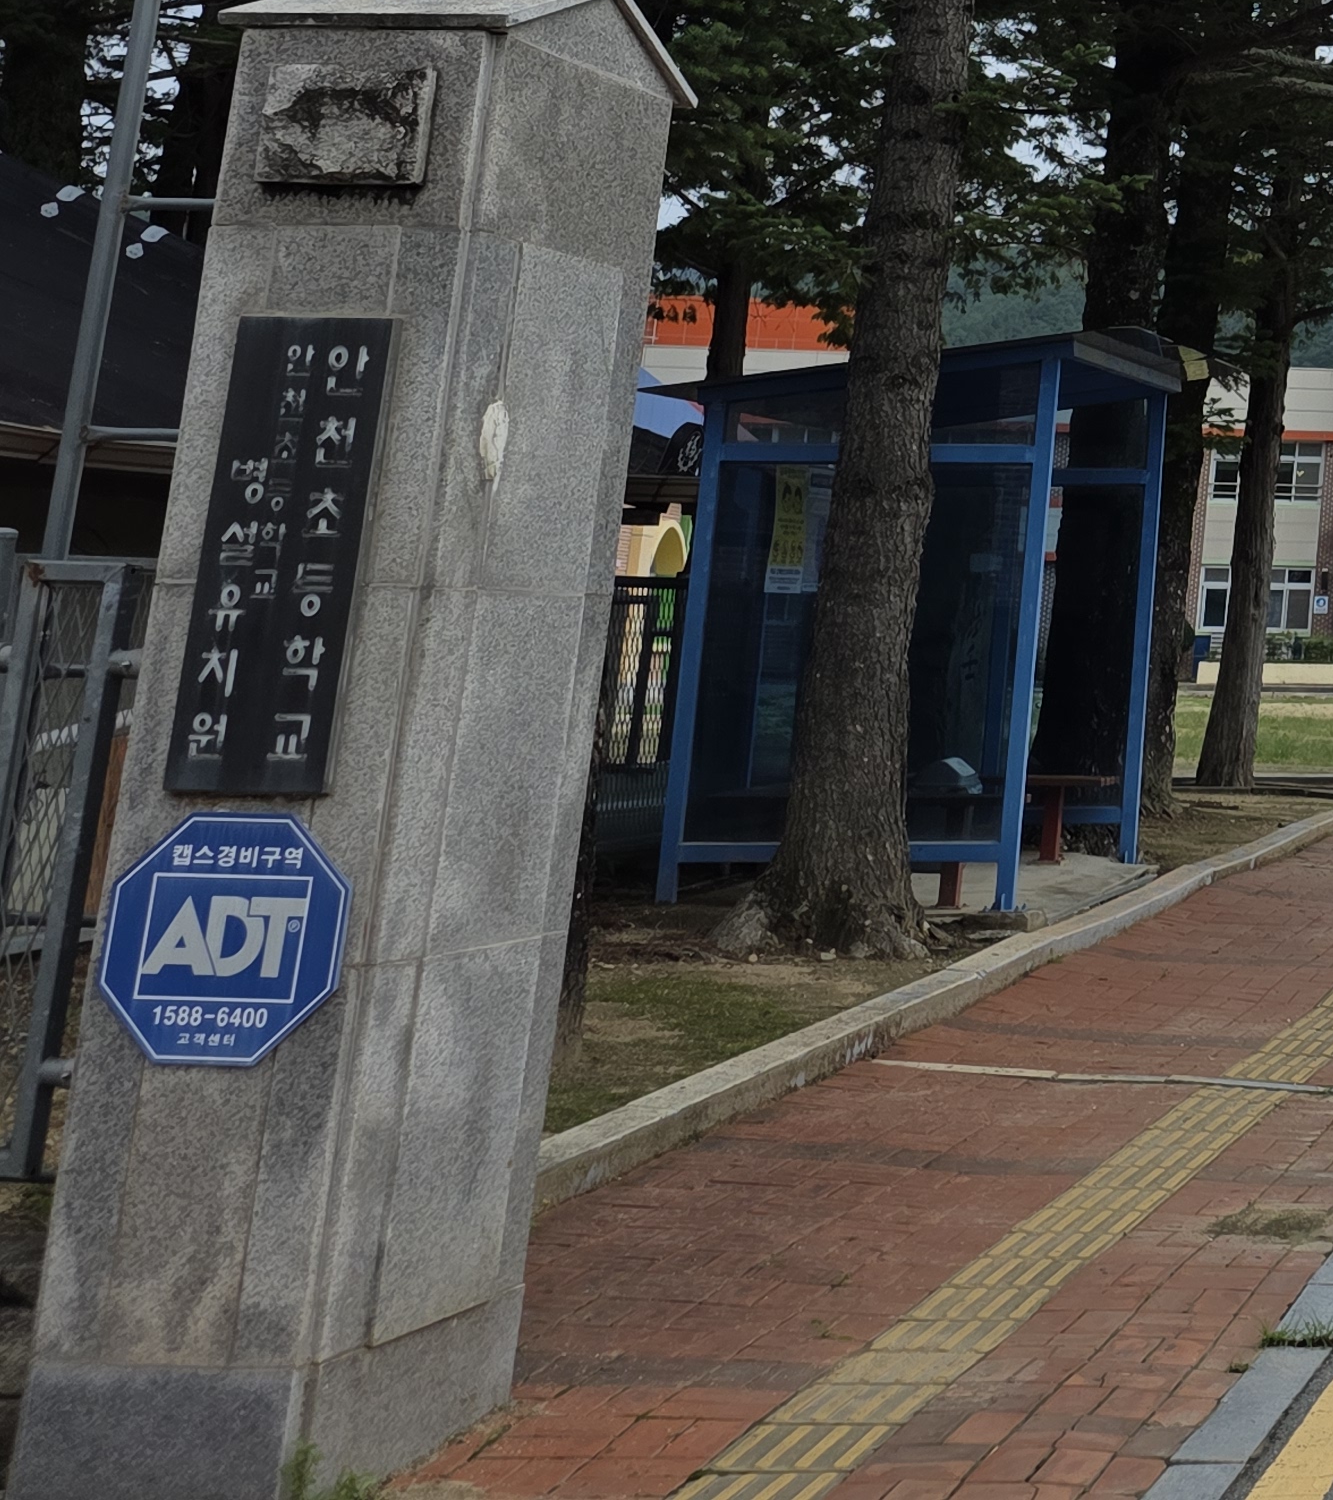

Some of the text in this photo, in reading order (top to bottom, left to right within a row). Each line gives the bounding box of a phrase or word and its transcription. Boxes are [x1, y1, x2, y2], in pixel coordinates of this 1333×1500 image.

[266, 344, 370, 762] 안천초등학교
[187, 456, 270, 762] 병설유치원
[171, 843, 305, 870] 캡스경비구역
[140, 894, 309, 979] ADT
[151, 1004, 269, 1030] 1588-6400
